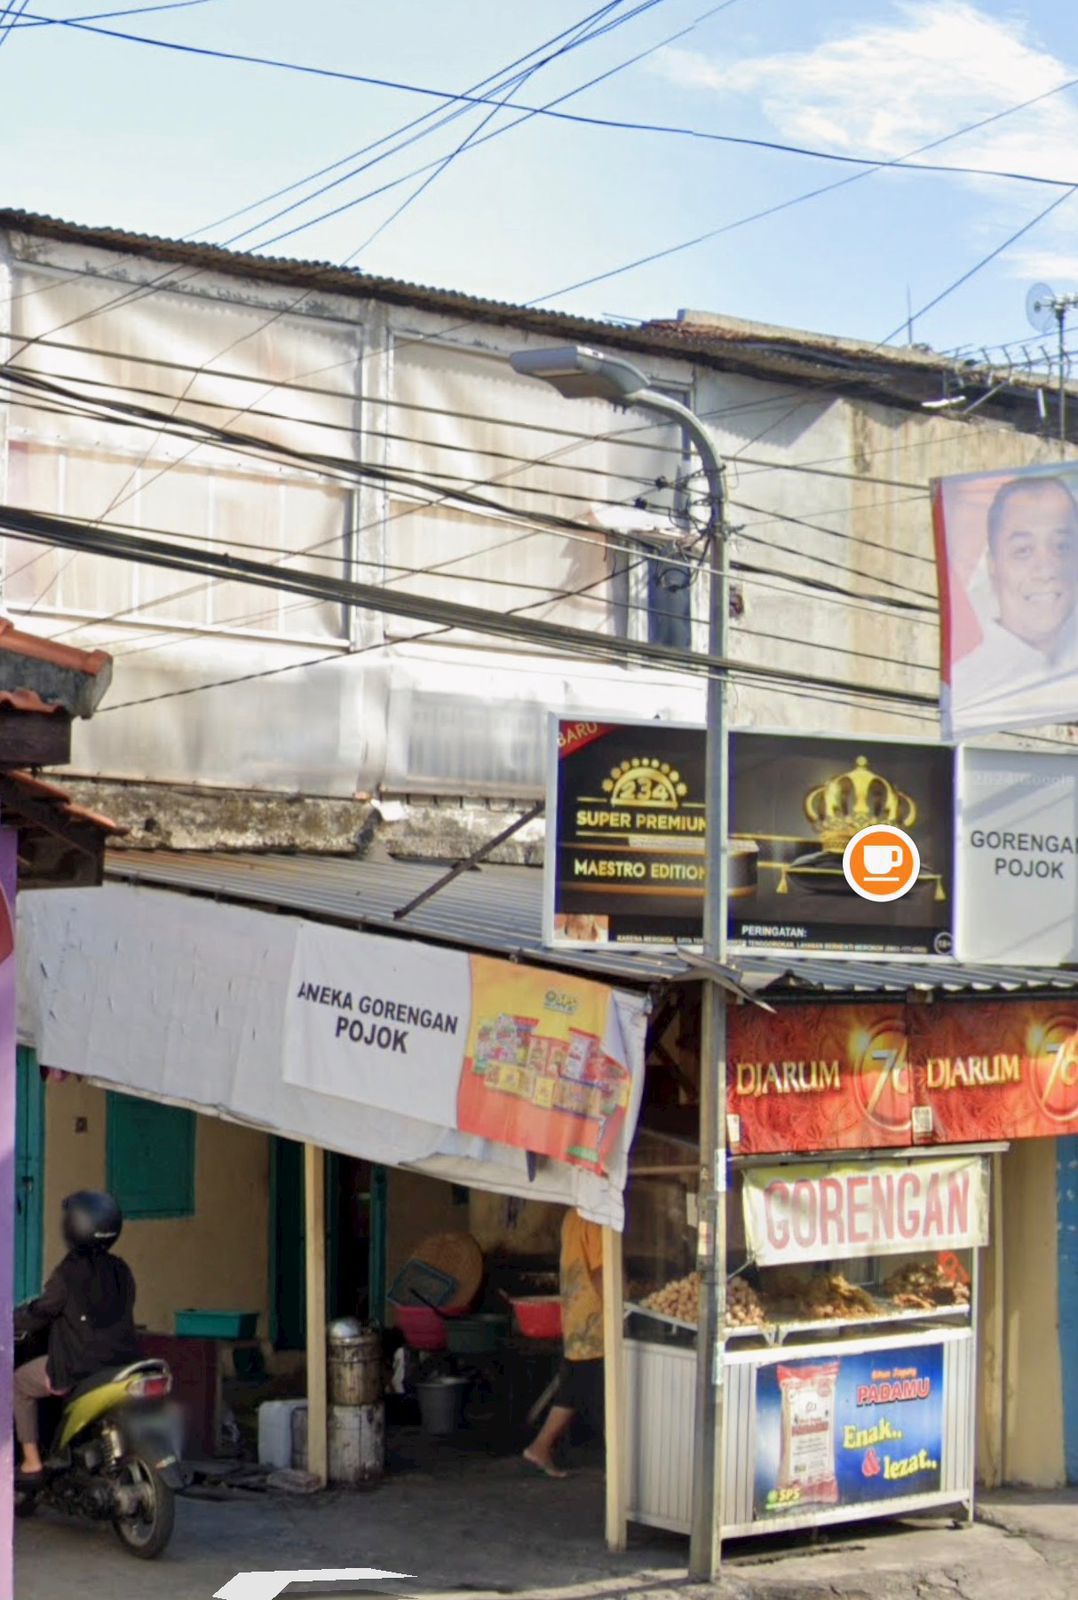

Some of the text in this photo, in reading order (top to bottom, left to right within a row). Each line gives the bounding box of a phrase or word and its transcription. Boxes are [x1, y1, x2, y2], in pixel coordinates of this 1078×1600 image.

[619, 778, 669, 801] 234
[576, 811, 632, 827] SUPER
[970, 830, 1078, 855] GORENGA
[574, 859, 646, 878] MAESTRO
[994, 857, 1064, 879] POJOK
[741, 924, 808, 938] PERINGATAN:
[297, 981, 458, 1035] ANEKA GORENGAN
[334, 1016, 408, 1054] POJOK
[736, 1059, 841, 1098] DJARUM
[926, 1053, 1020, 1089] DJARUM
[764, 1172, 970, 1249] GORENGAN
[843, 1418, 903, 1449] Enak..
[883, 1449, 937, 1480] lezat..
